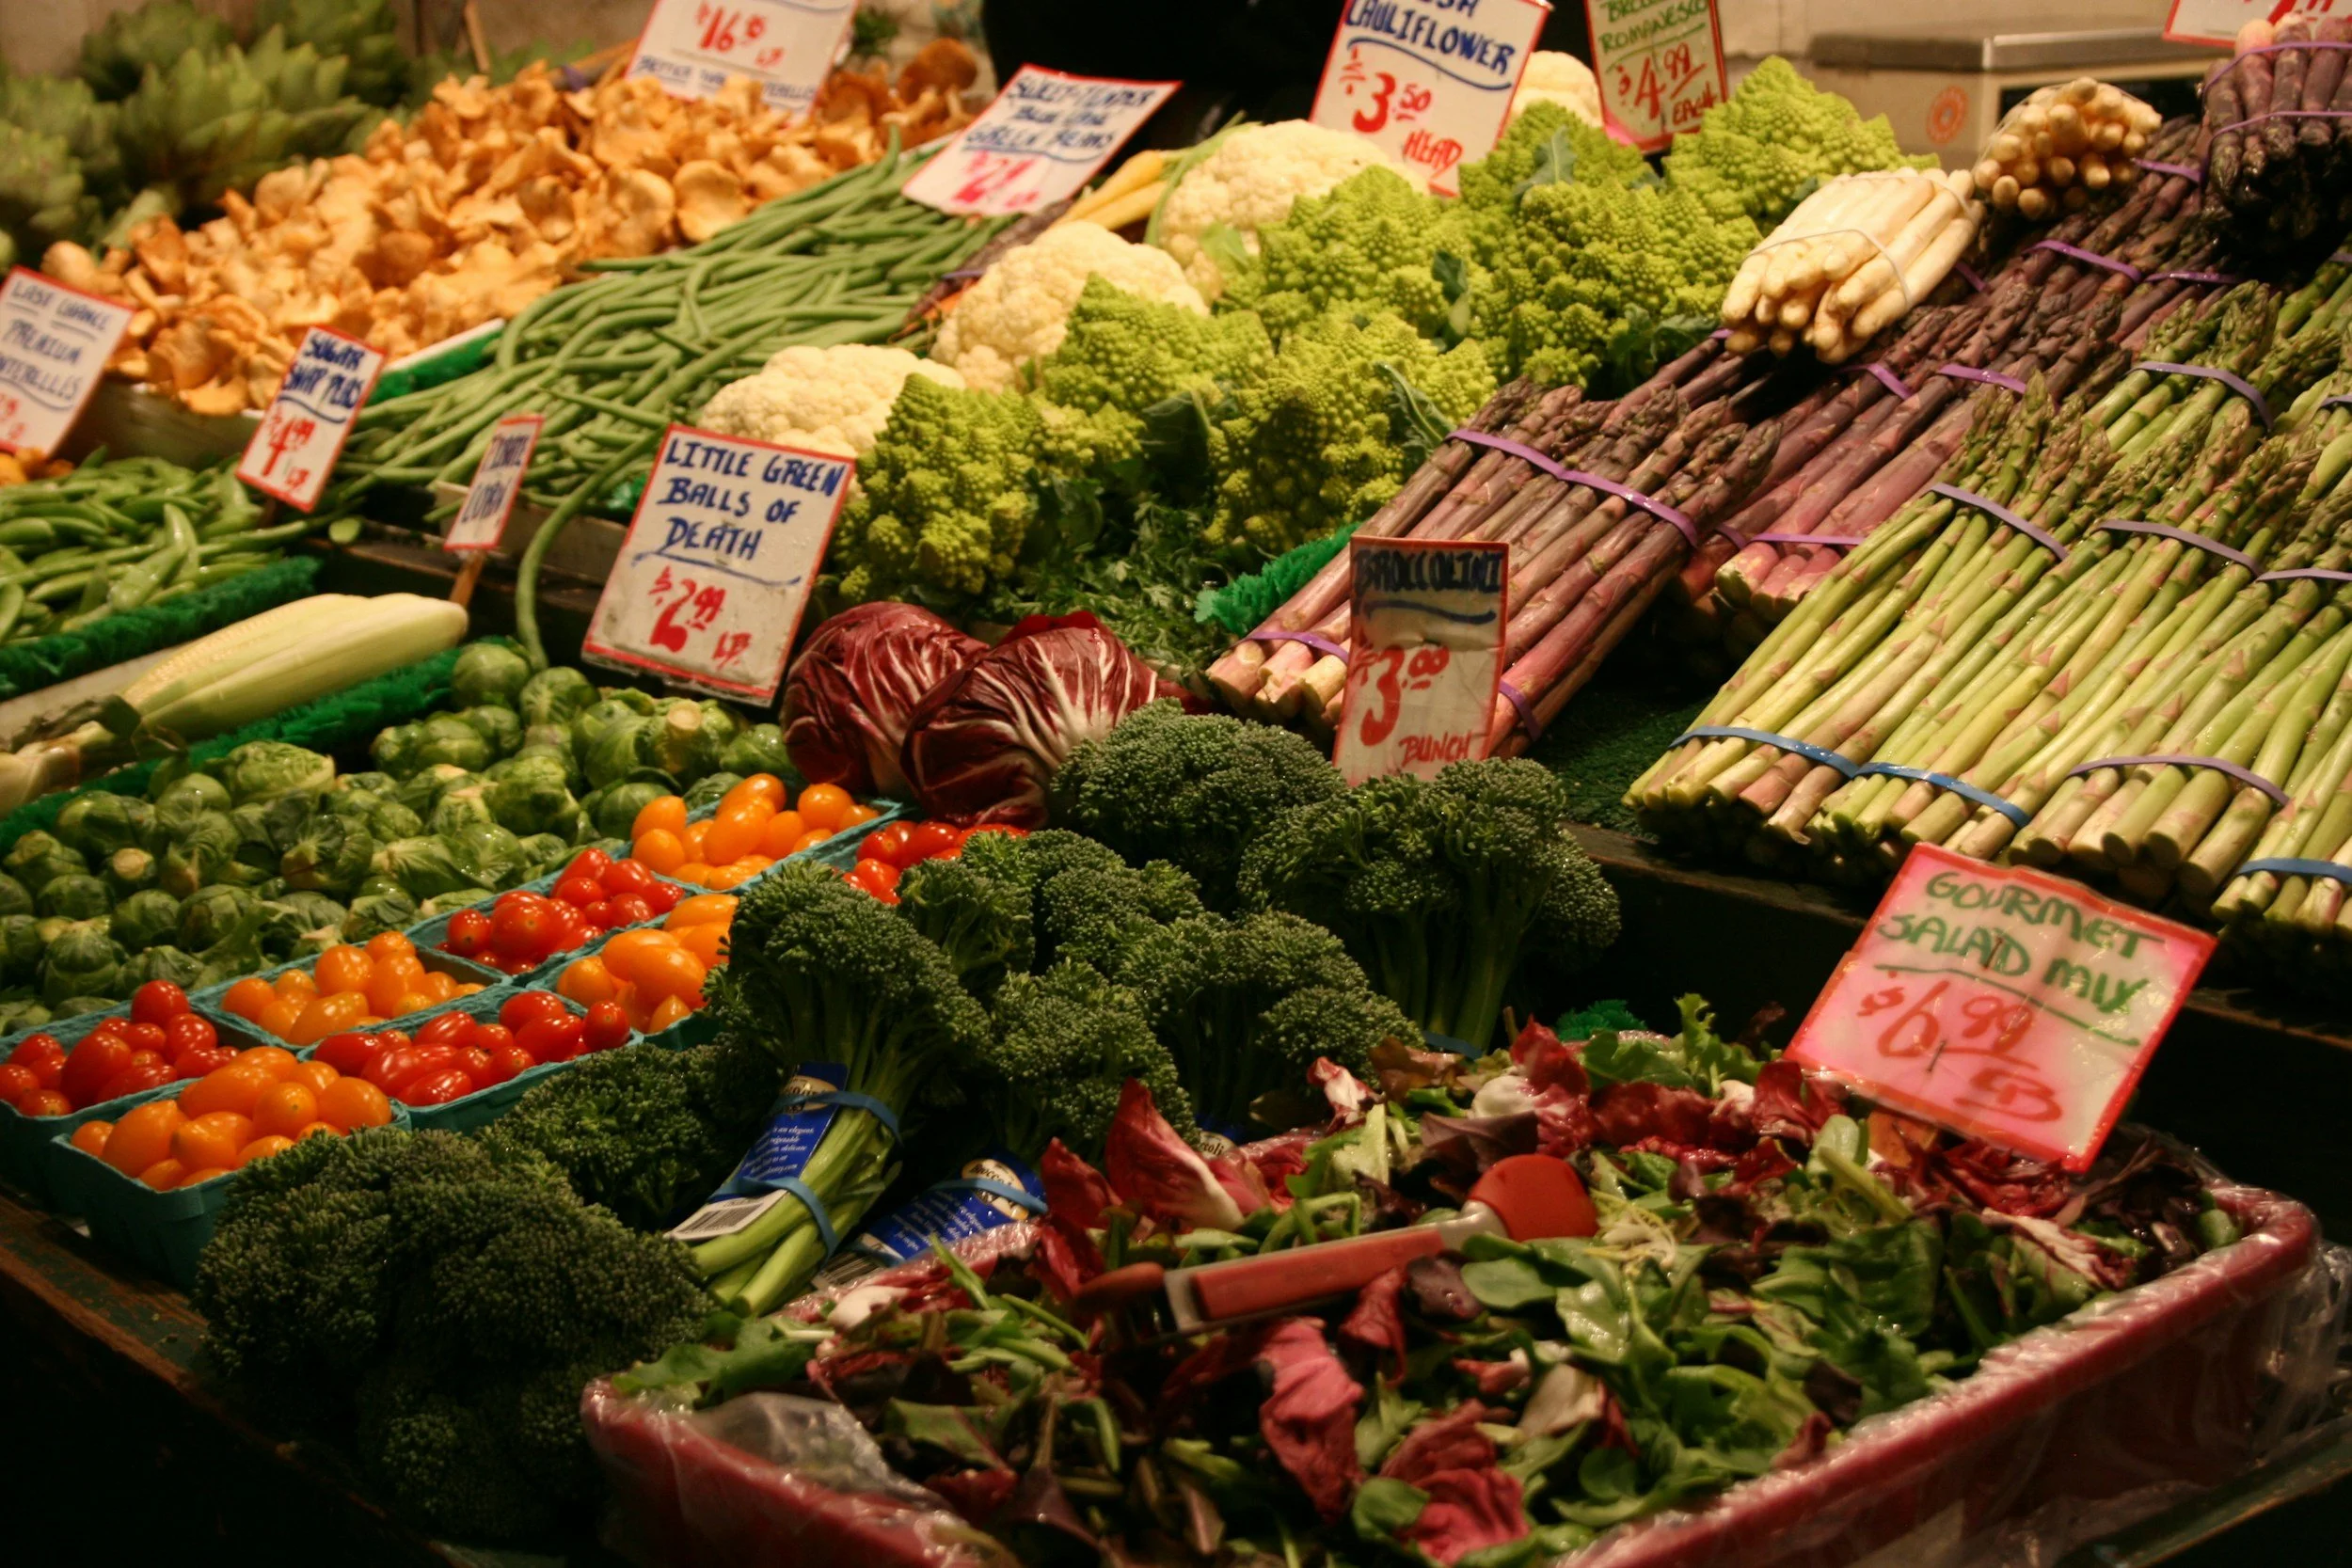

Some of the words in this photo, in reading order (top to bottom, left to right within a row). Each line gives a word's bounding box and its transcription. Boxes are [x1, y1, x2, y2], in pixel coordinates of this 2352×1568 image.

[1346, 0, 1515, 75] CAULIFLOWER
[664, 437, 754, 478] LITTLE
[762, 454, 845, 497] GREEN
[657, 477, 751, 518] BALLS
[765, 499, 802, 523] OF
[659, 516, 763, 562] DEATH
[1398, 732, 1473, 767] BUNCH
[1925, 871, 2166, 959] GOURMET
[1876, 912, 2031, 977] SALAD
[2042, 957, 2150, 1015] MIX
